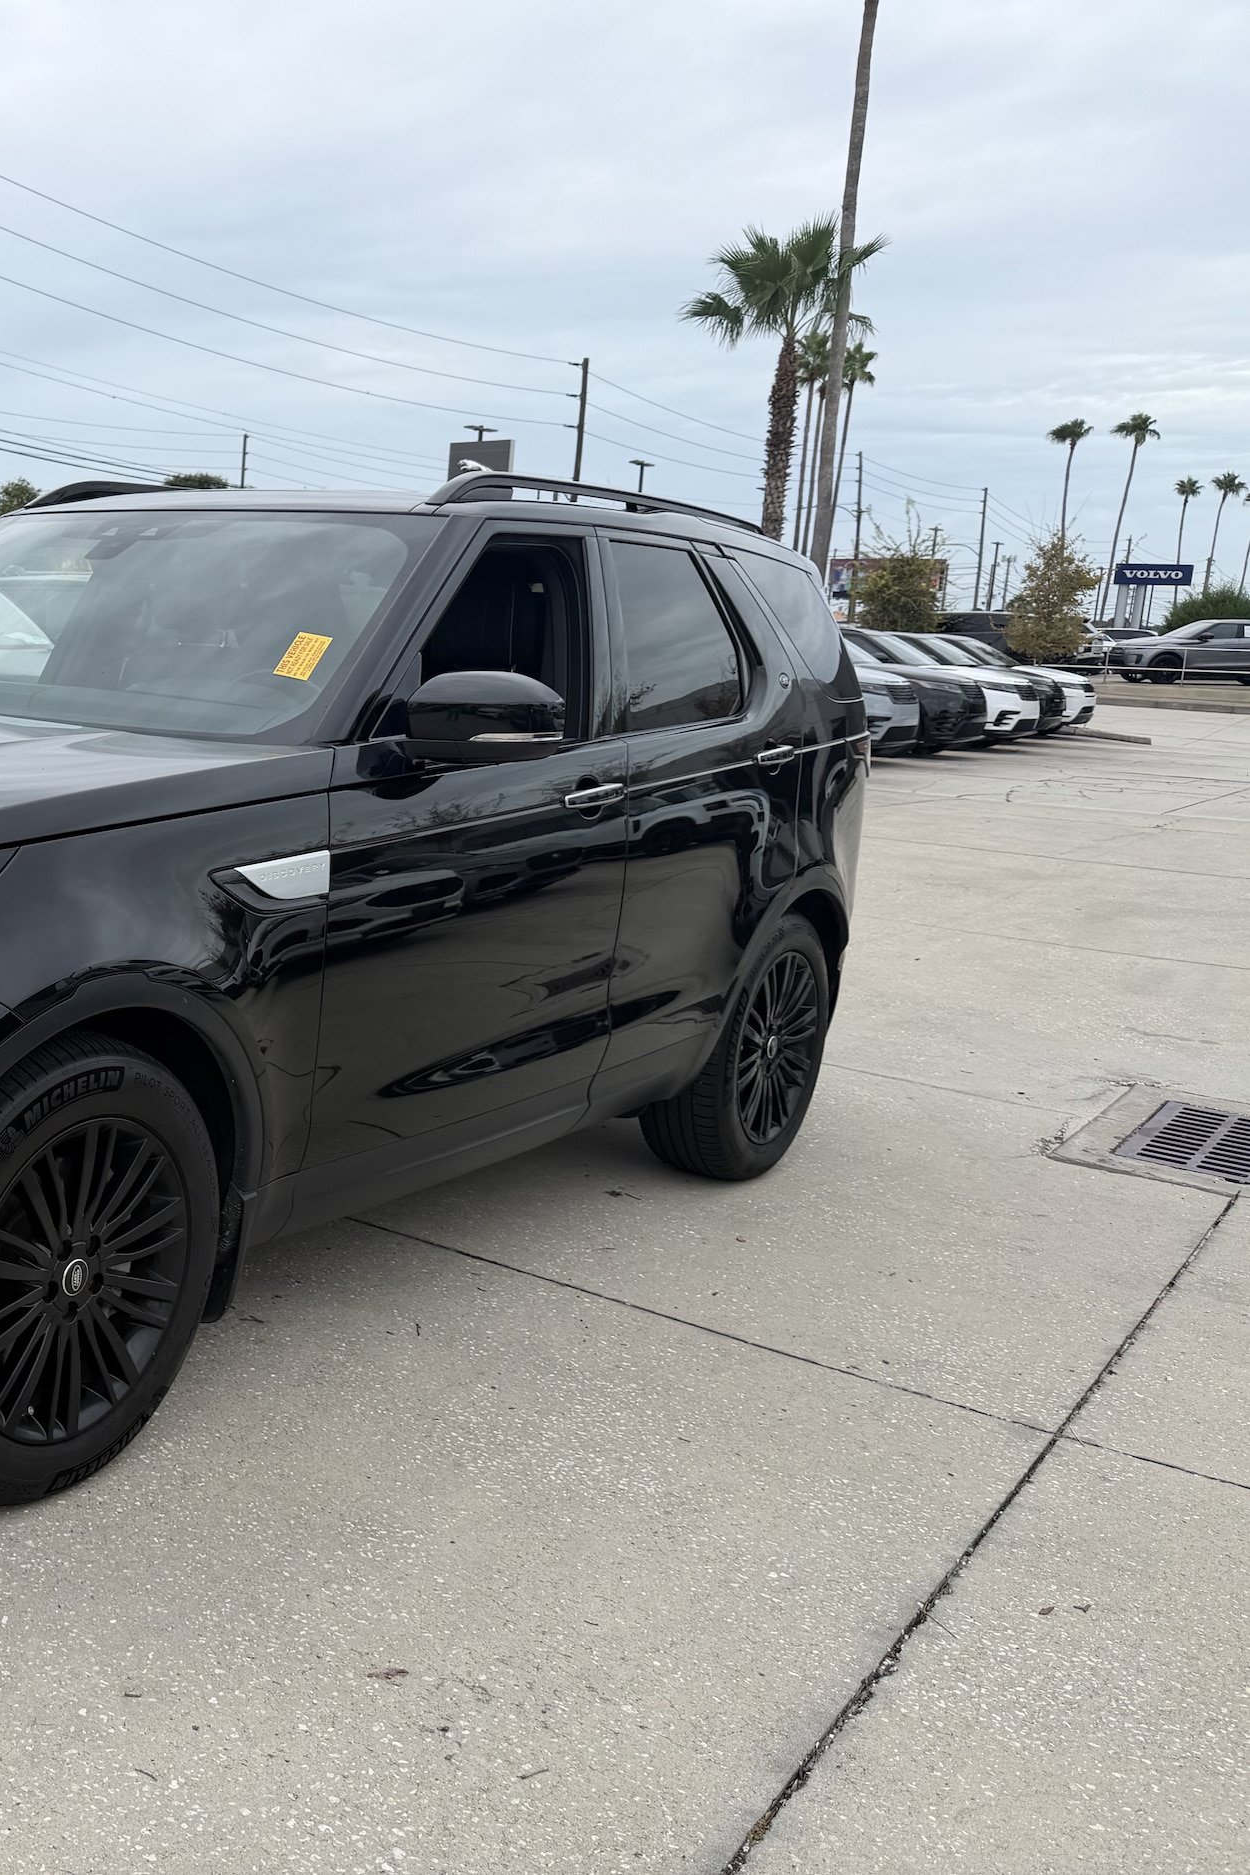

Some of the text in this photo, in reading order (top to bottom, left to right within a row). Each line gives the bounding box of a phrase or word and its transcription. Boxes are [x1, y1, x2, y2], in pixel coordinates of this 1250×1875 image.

[1123, 570, 1183, 579] VOLVO
[276, 659, 290, 673] THIS
[285, 636, 307, 659] VEHICLE
[260, 862, 326, 882] DISCOVERY
[24, 1070, 120, 1131] MICHELIN
[134, 1072, 162, 1088] PILOT
[163, 1086, 190, 1117] SPORT
